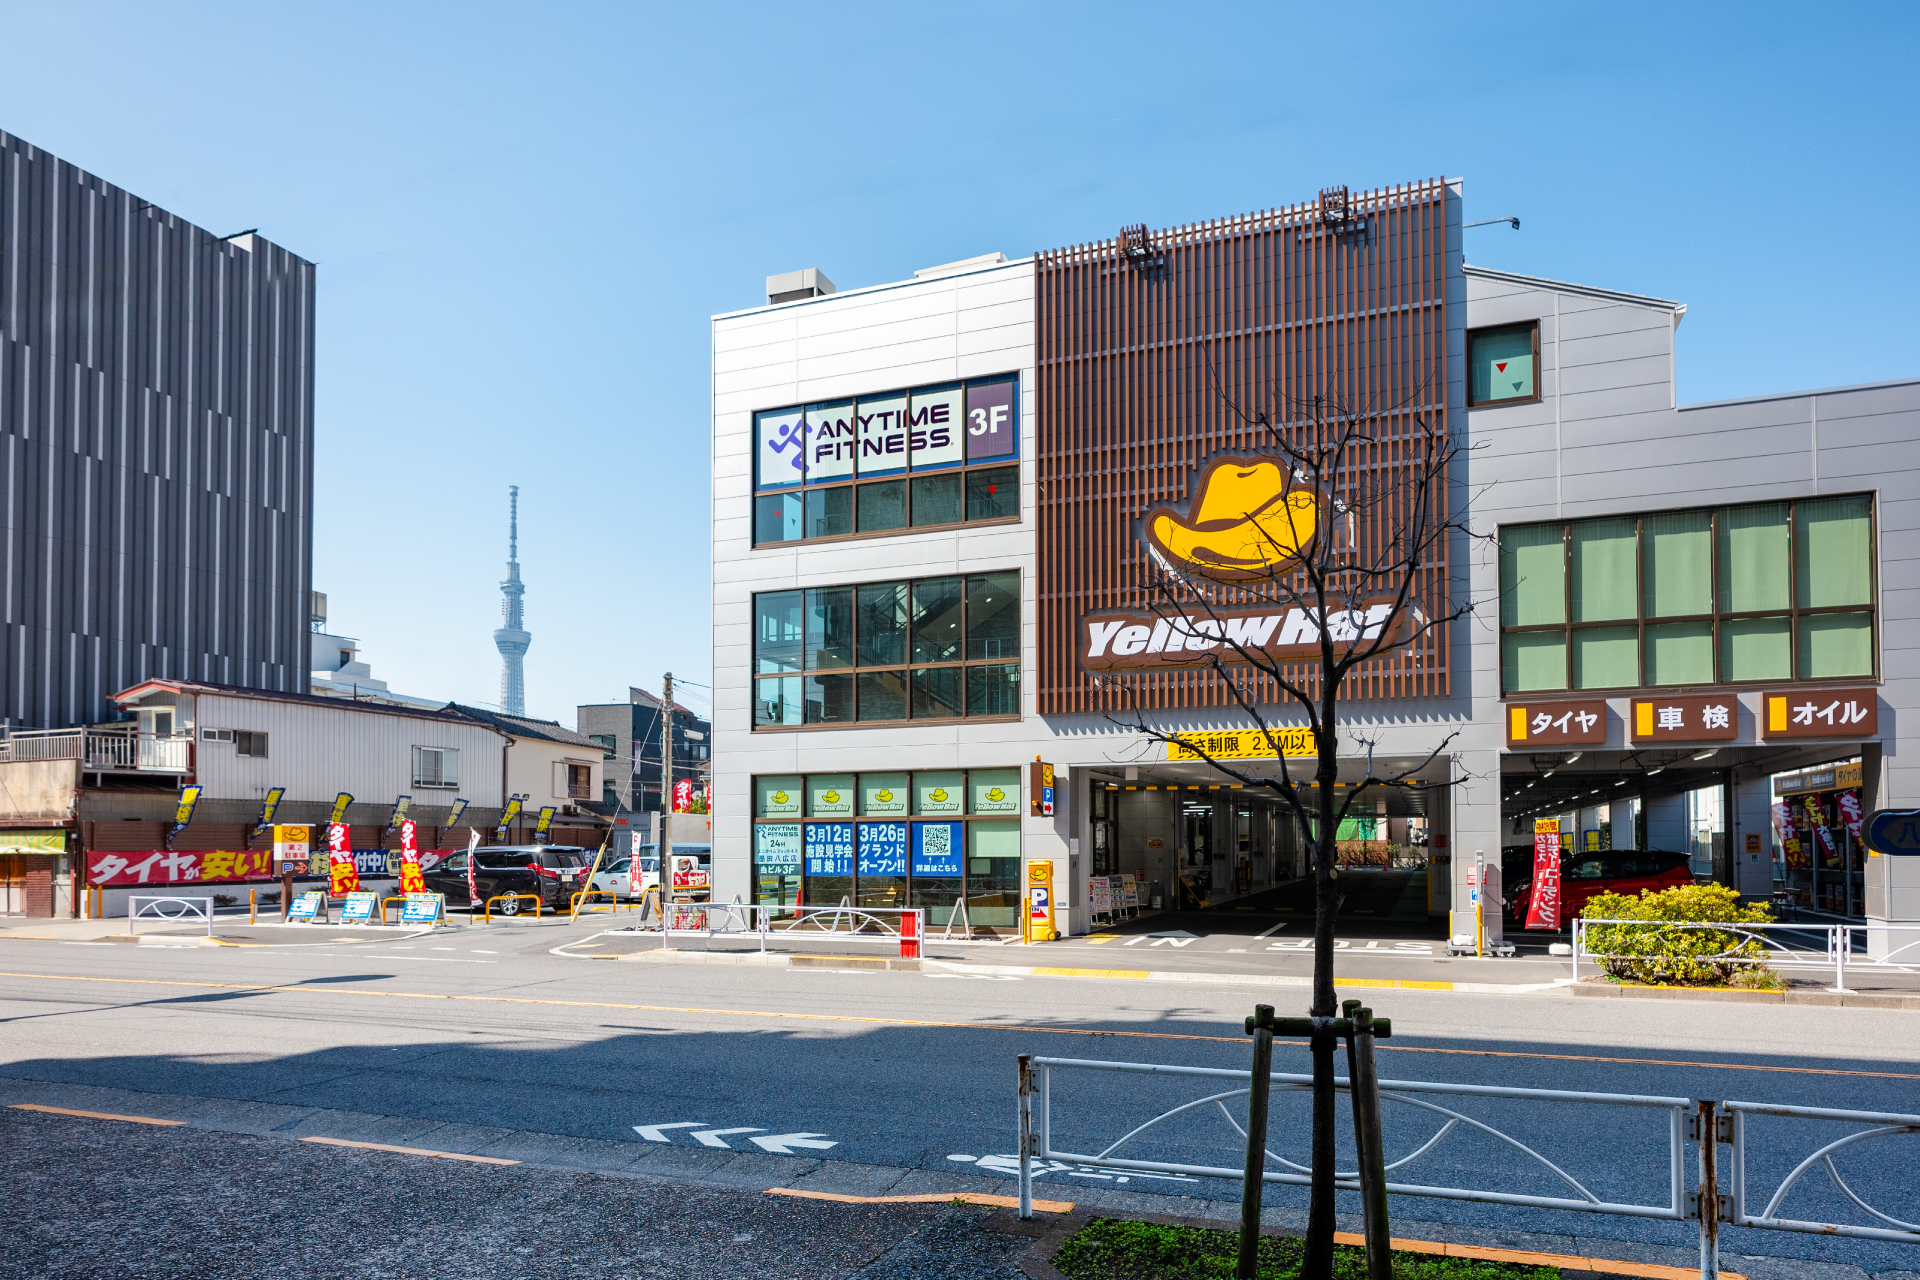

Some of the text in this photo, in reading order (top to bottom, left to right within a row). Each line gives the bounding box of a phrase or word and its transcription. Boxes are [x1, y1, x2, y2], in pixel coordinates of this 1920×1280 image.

[816, 403, 950, 440] ANYTIME
[968, 404, 1009, 436] 3F
[815, 427, 950, 463] FITNESS
[1793, 700, 1869, 726] オイル
[1531, 710, 1598, 735] タイヤ
[1178, 736, 1240, 754] 高さ制限
[1045, 788, 1051, 801] P
[806, 825, 851, 843] 3月12日
[859, 824, 906, 843] 3月26日
[770, 839, 786, 848] 24H
[805, 844, 854, 859] 施設見学会
[859, 844, 905, 858] グランド
[90, 850, 272, 885] タイヤが安い!
[283, 862, 294, 875] P
[760, 865, 795, 875] 当ビル3F
[811, 859, 848, 873] 開始!!
[859, 859, 905, 873] オープン!!
[916, 864, 958, 872] 詳細はこちら
[1031, 889, 1048, 906] P
